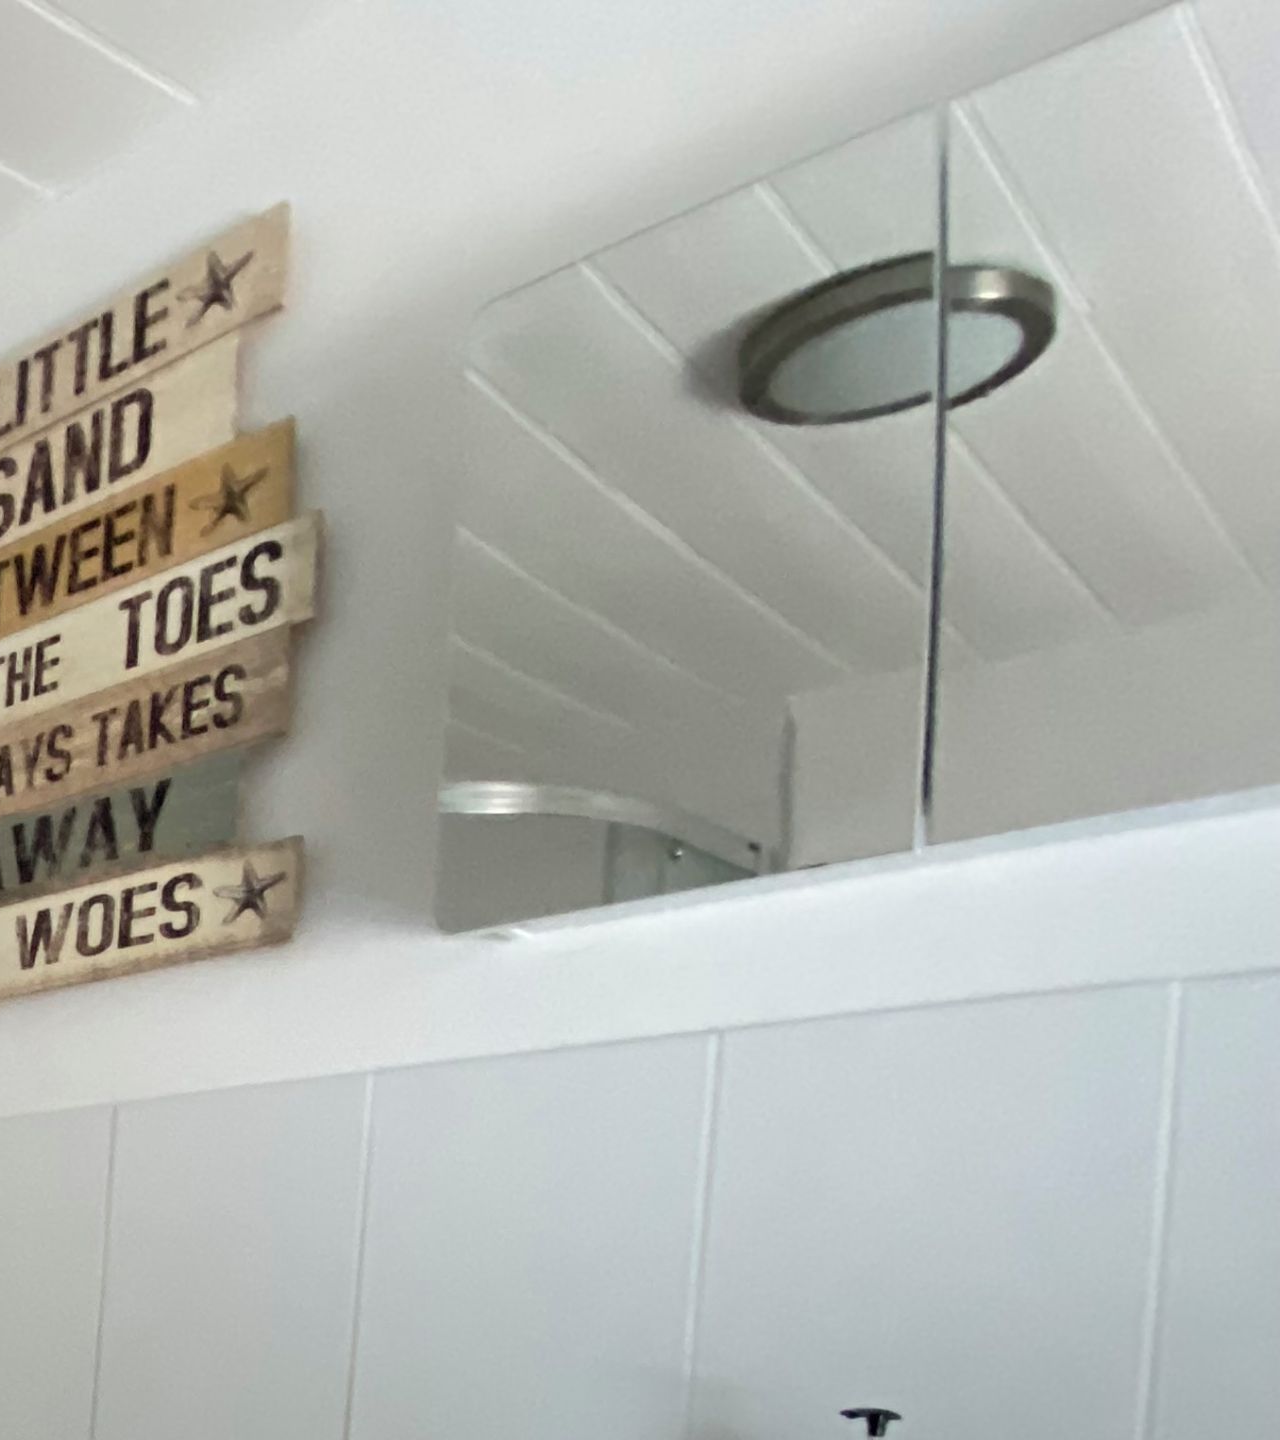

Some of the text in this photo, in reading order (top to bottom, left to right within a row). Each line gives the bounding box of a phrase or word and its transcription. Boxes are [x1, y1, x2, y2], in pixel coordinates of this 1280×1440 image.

[118, 540, 283, 671] TOES
[91, 663, 248, 767] TAKES
[14, 872, 203, 970] WOES
